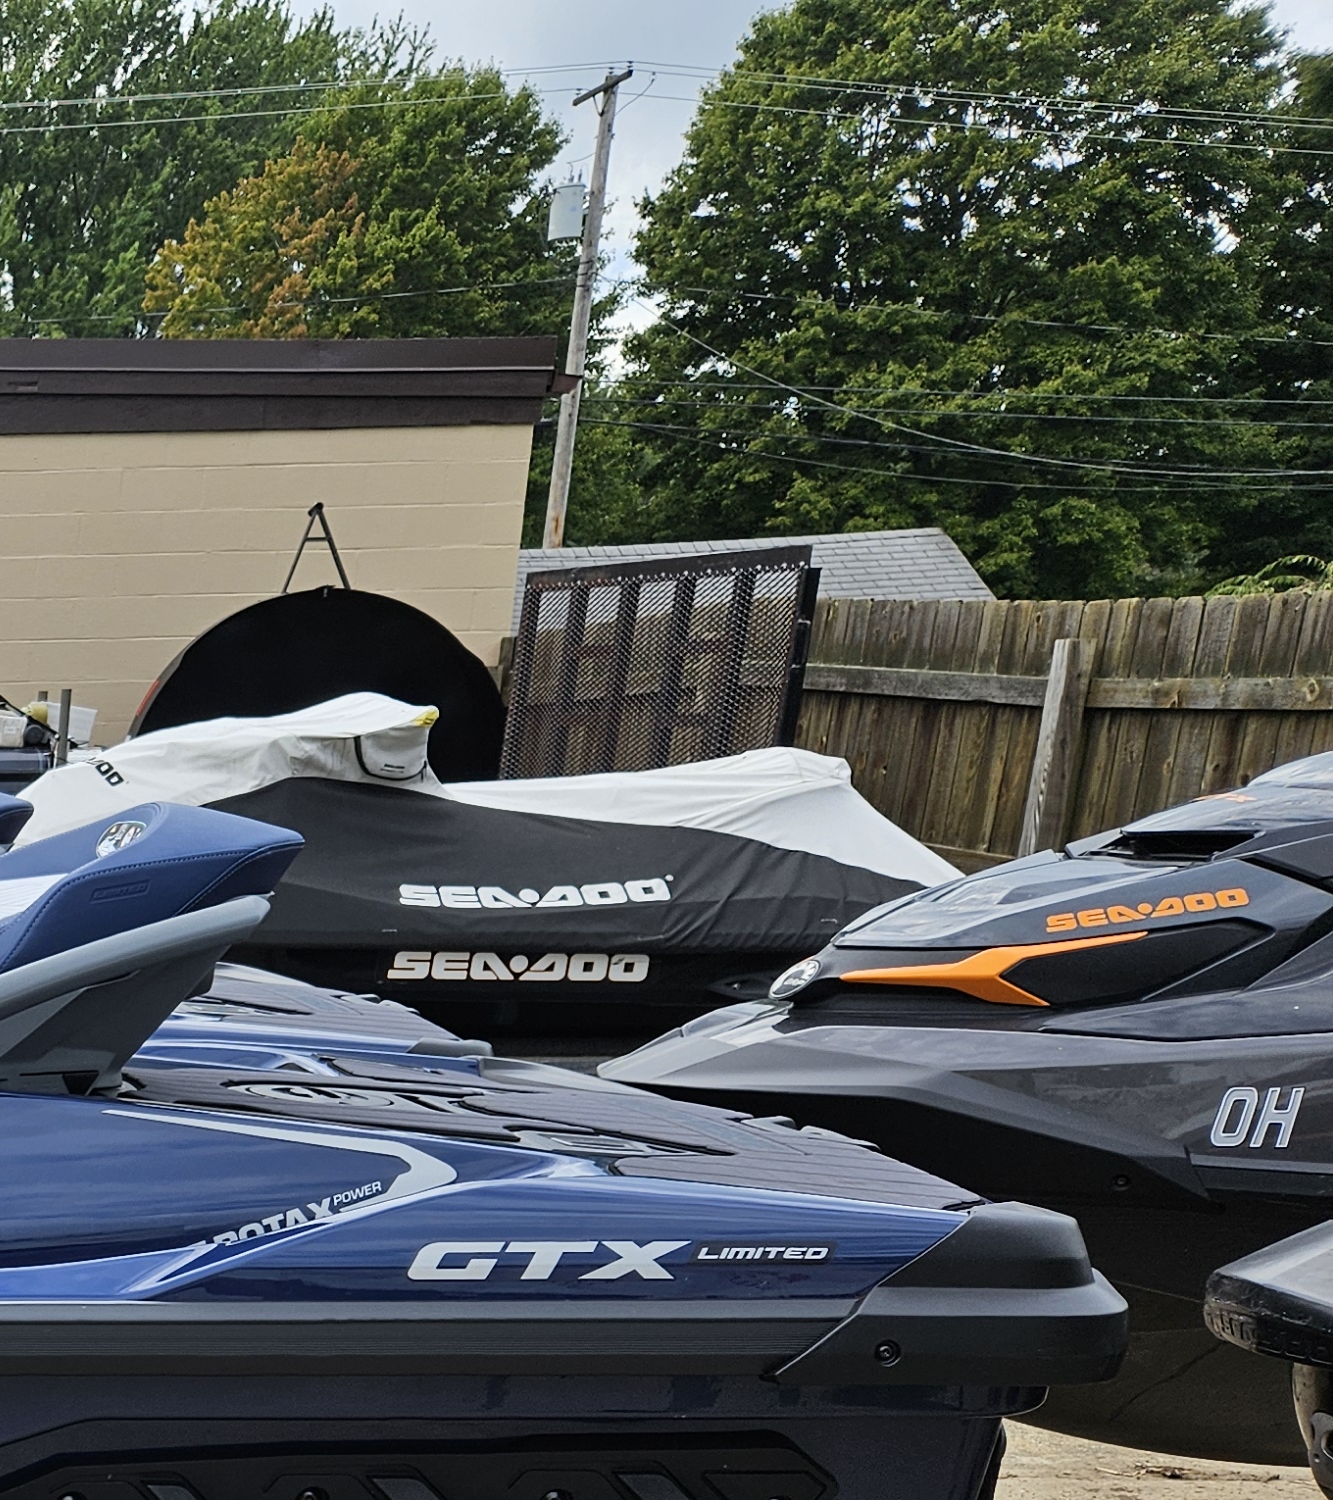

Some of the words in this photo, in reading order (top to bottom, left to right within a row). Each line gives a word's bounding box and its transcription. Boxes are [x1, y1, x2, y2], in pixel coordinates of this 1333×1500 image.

[1210, 1086, 1305, 1148] OH
[333, 1180, 382, 1206] POWER
[406, 1240, 693, 1280] GTX
[697, 1245, 830, 1261] LIMITED
